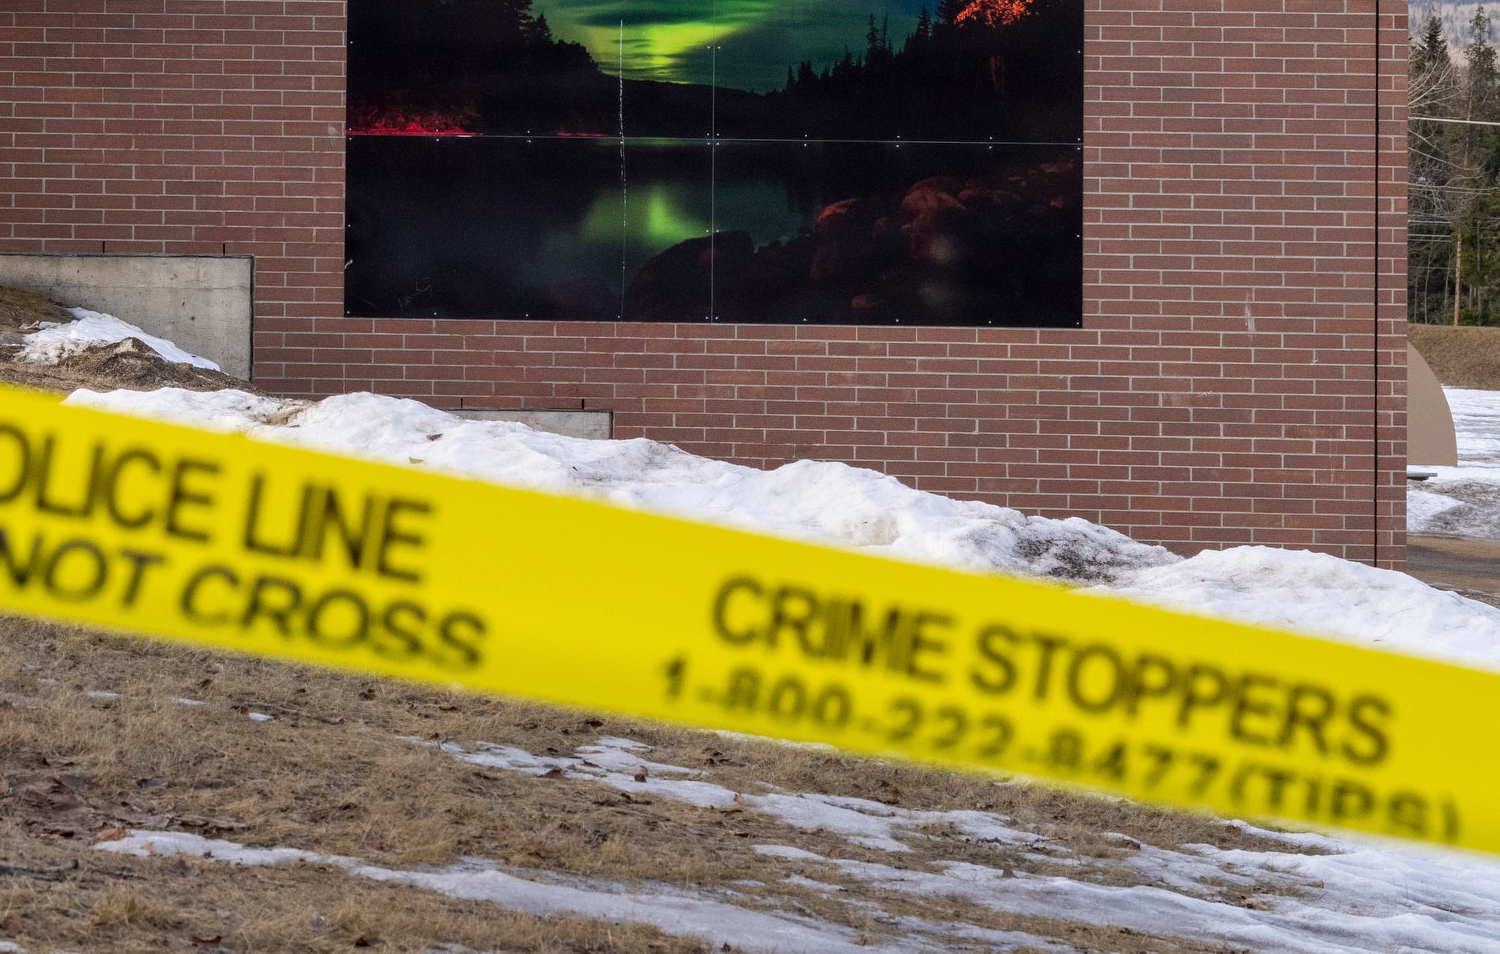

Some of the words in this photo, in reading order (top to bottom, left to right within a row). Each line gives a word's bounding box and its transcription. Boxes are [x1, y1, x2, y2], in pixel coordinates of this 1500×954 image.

[242, 467, 435, 584] LINE
[178, 562, 490, 670] CROSS
[711, 575, 954, 686] CRIME
[968, 622, 1396, 768] STOPPERS
